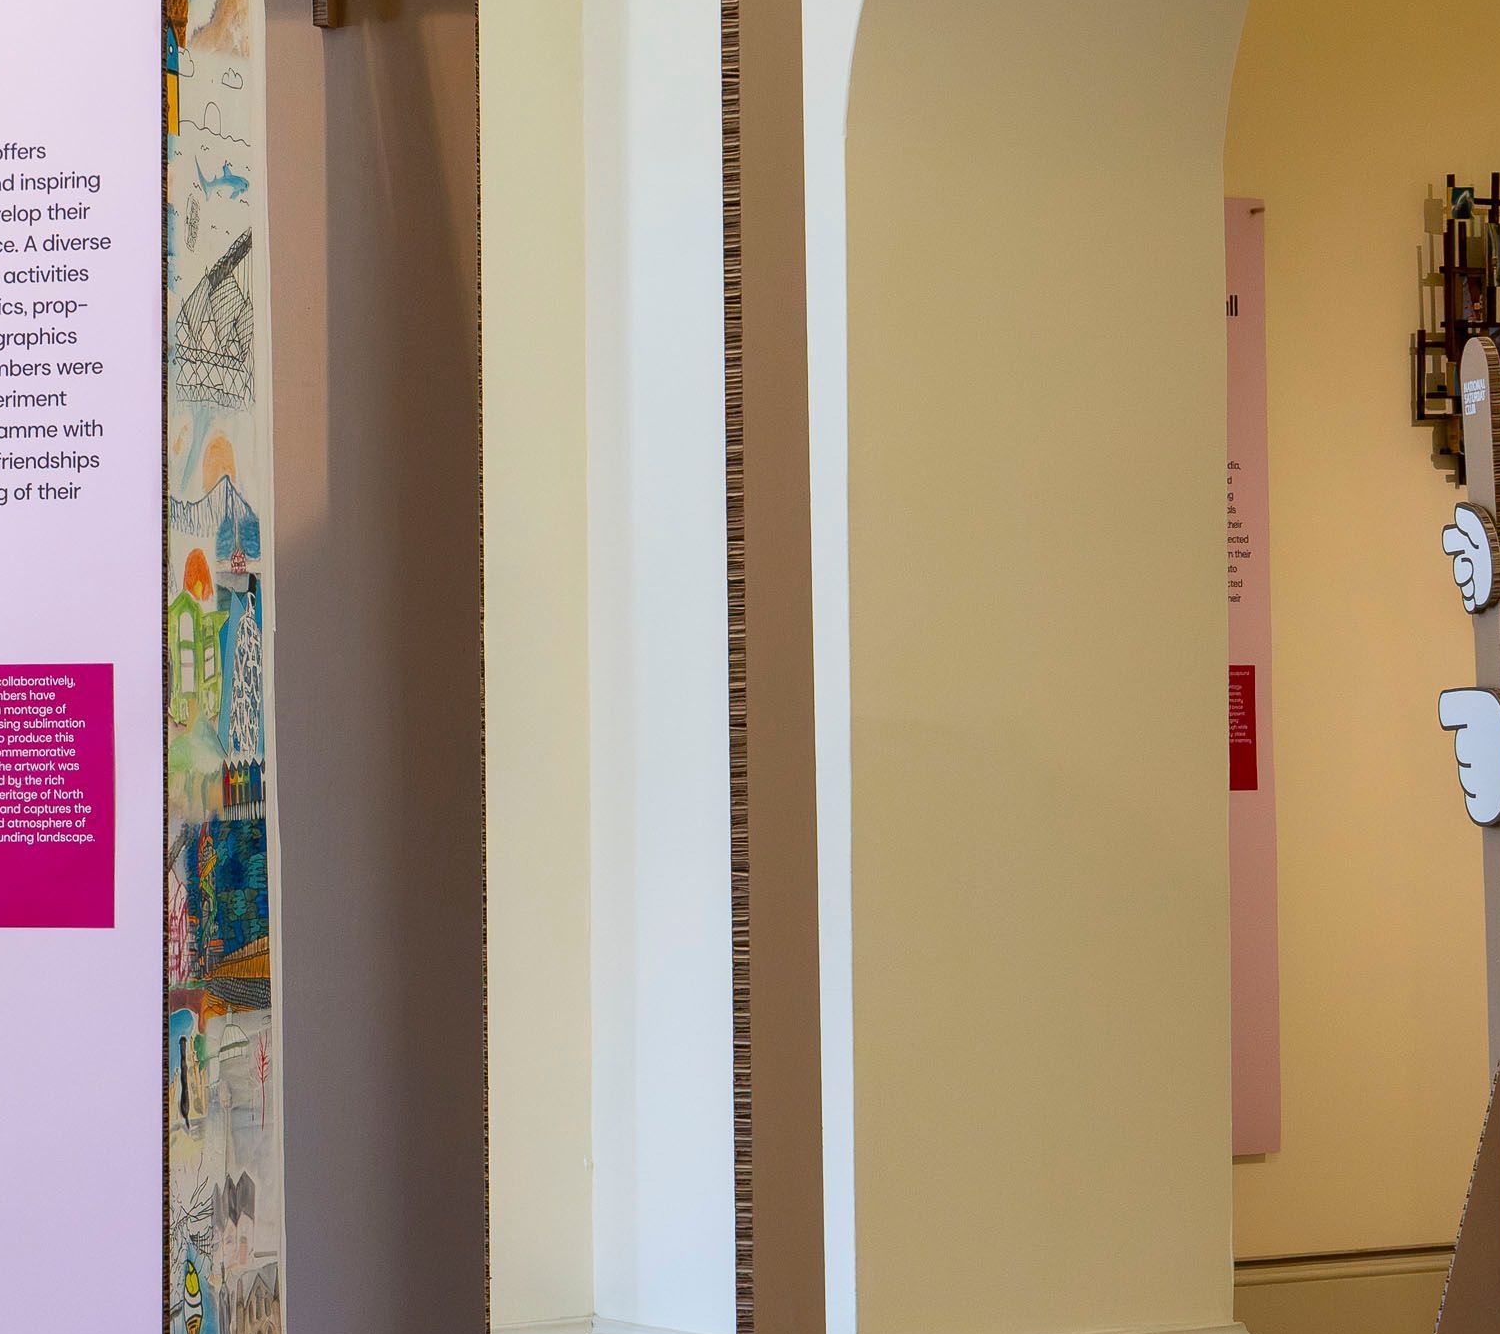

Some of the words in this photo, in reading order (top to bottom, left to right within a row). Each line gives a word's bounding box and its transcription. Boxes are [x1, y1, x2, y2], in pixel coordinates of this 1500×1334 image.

[20, 171, 100, 195] inspiring
[47, 202, 91, 221] their
[29, 689, 56, 701] have
